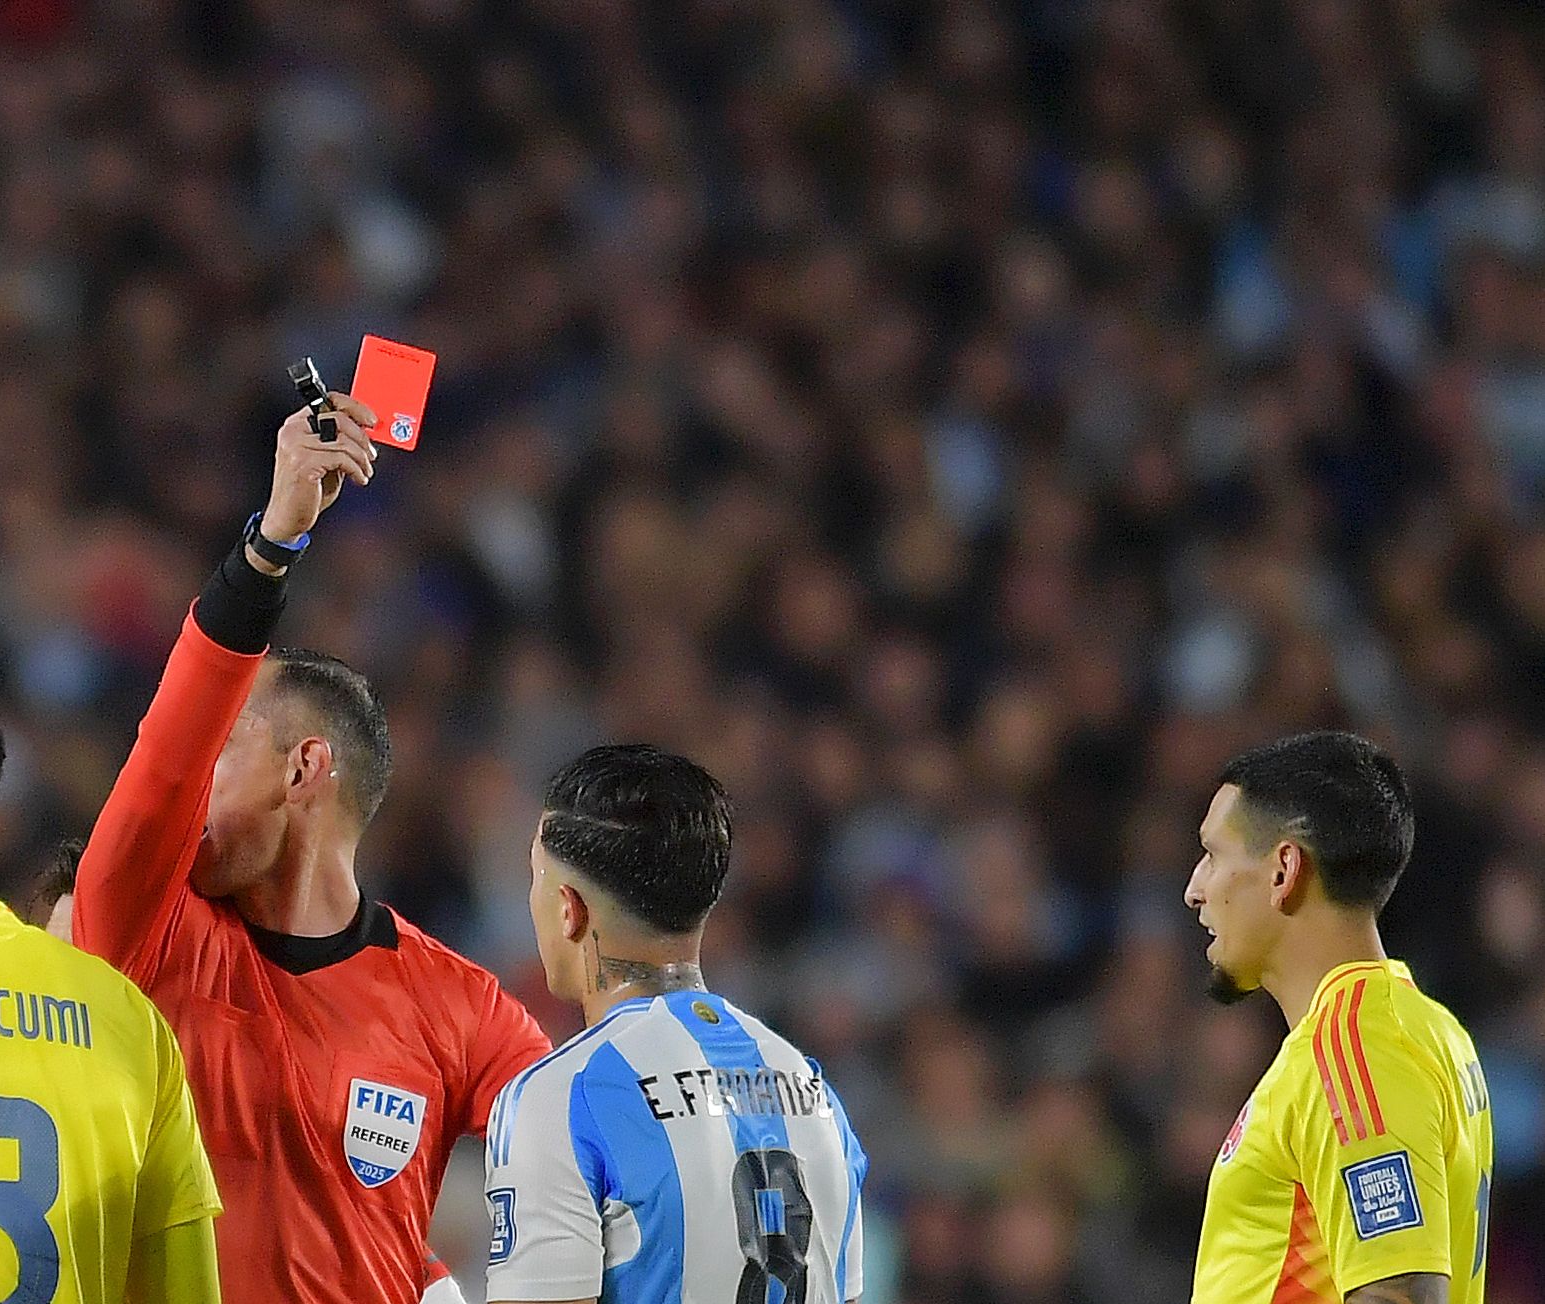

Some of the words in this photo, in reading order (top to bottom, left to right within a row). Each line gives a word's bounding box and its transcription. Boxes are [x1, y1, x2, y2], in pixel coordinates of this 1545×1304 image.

[356, 1087, 415, 1125] FIFA
[350, 1125, 410, 1154] REFEREE
[357, 1162, 386, 1180] 2025
[1362, 1177, 1402, 1201] UNITES
